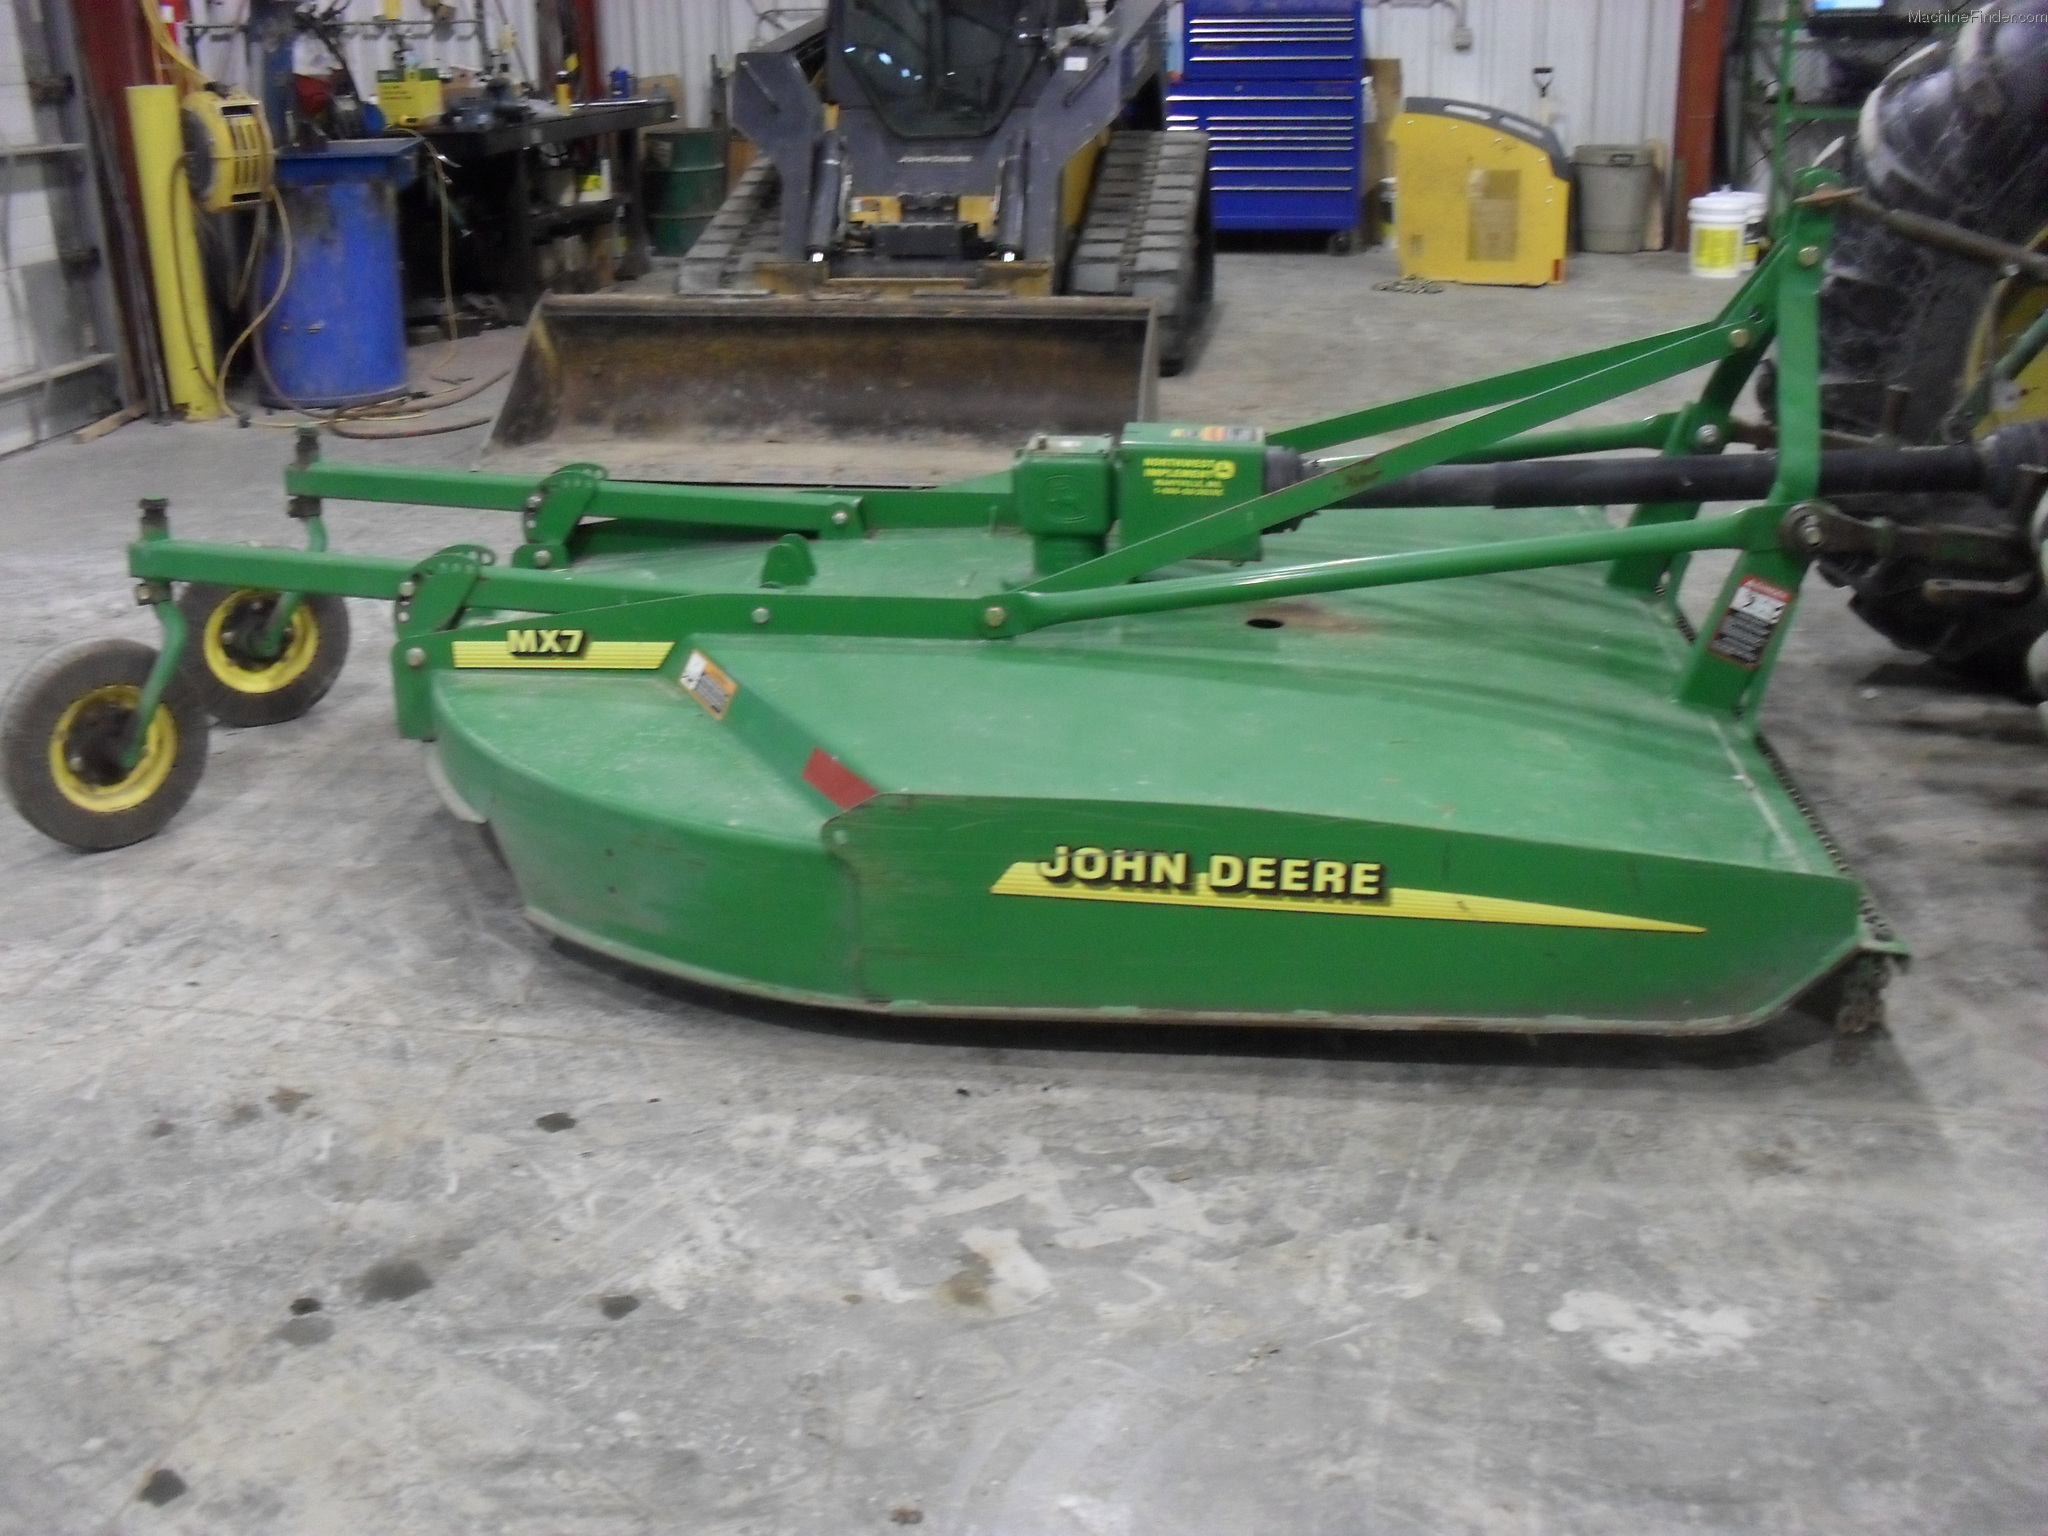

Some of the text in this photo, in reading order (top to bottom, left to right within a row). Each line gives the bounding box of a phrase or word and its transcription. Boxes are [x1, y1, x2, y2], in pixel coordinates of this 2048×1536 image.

[506, 629, 585, 656] MX7
[1039, 844, 1384, 899] JOHN DEERE
